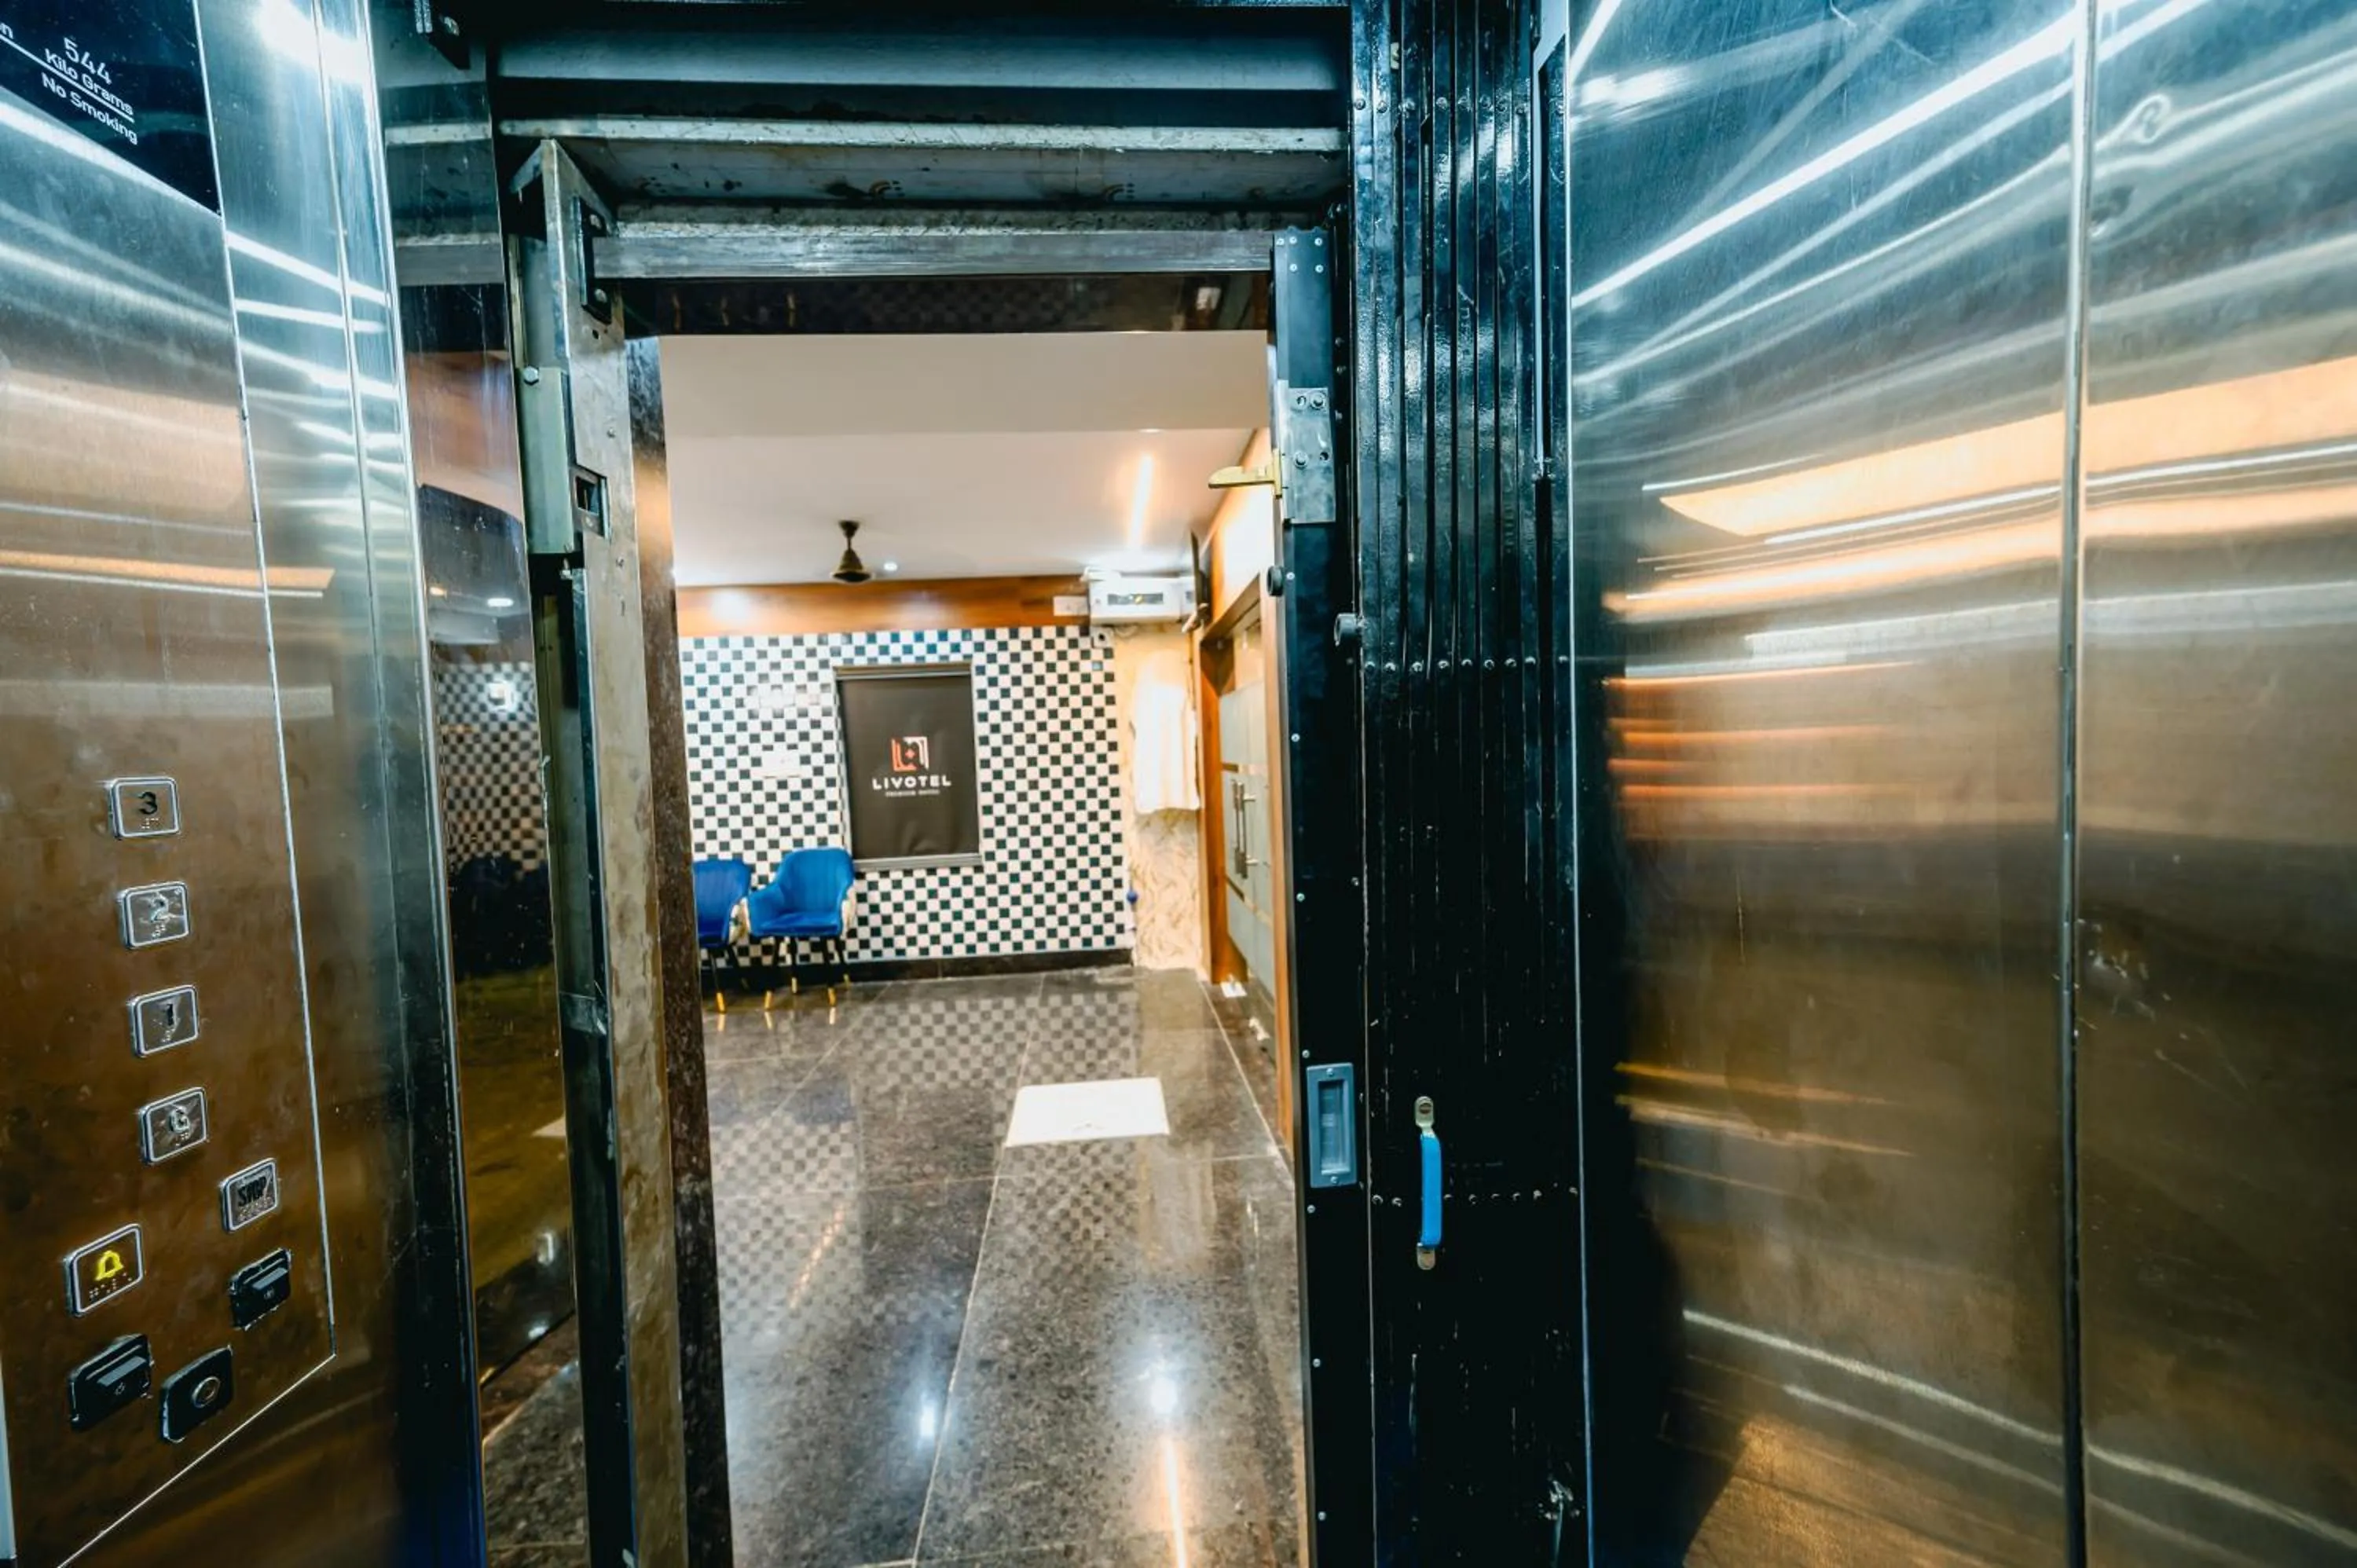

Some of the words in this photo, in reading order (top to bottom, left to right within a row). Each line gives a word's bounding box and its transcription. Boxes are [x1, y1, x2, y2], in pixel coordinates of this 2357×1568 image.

[64, 37, 112, 85] 544
[45, 48, 79, 79] Kilo
[82, 73, 134, 115] Grams
[42, 71, 67, 98] No
[70, 91, 138, 145] Smoking
[871, 774, 952, 790] LIVOTEL
[137, 791, 158, 815] 3
[149, 892, 170, 923] 2
